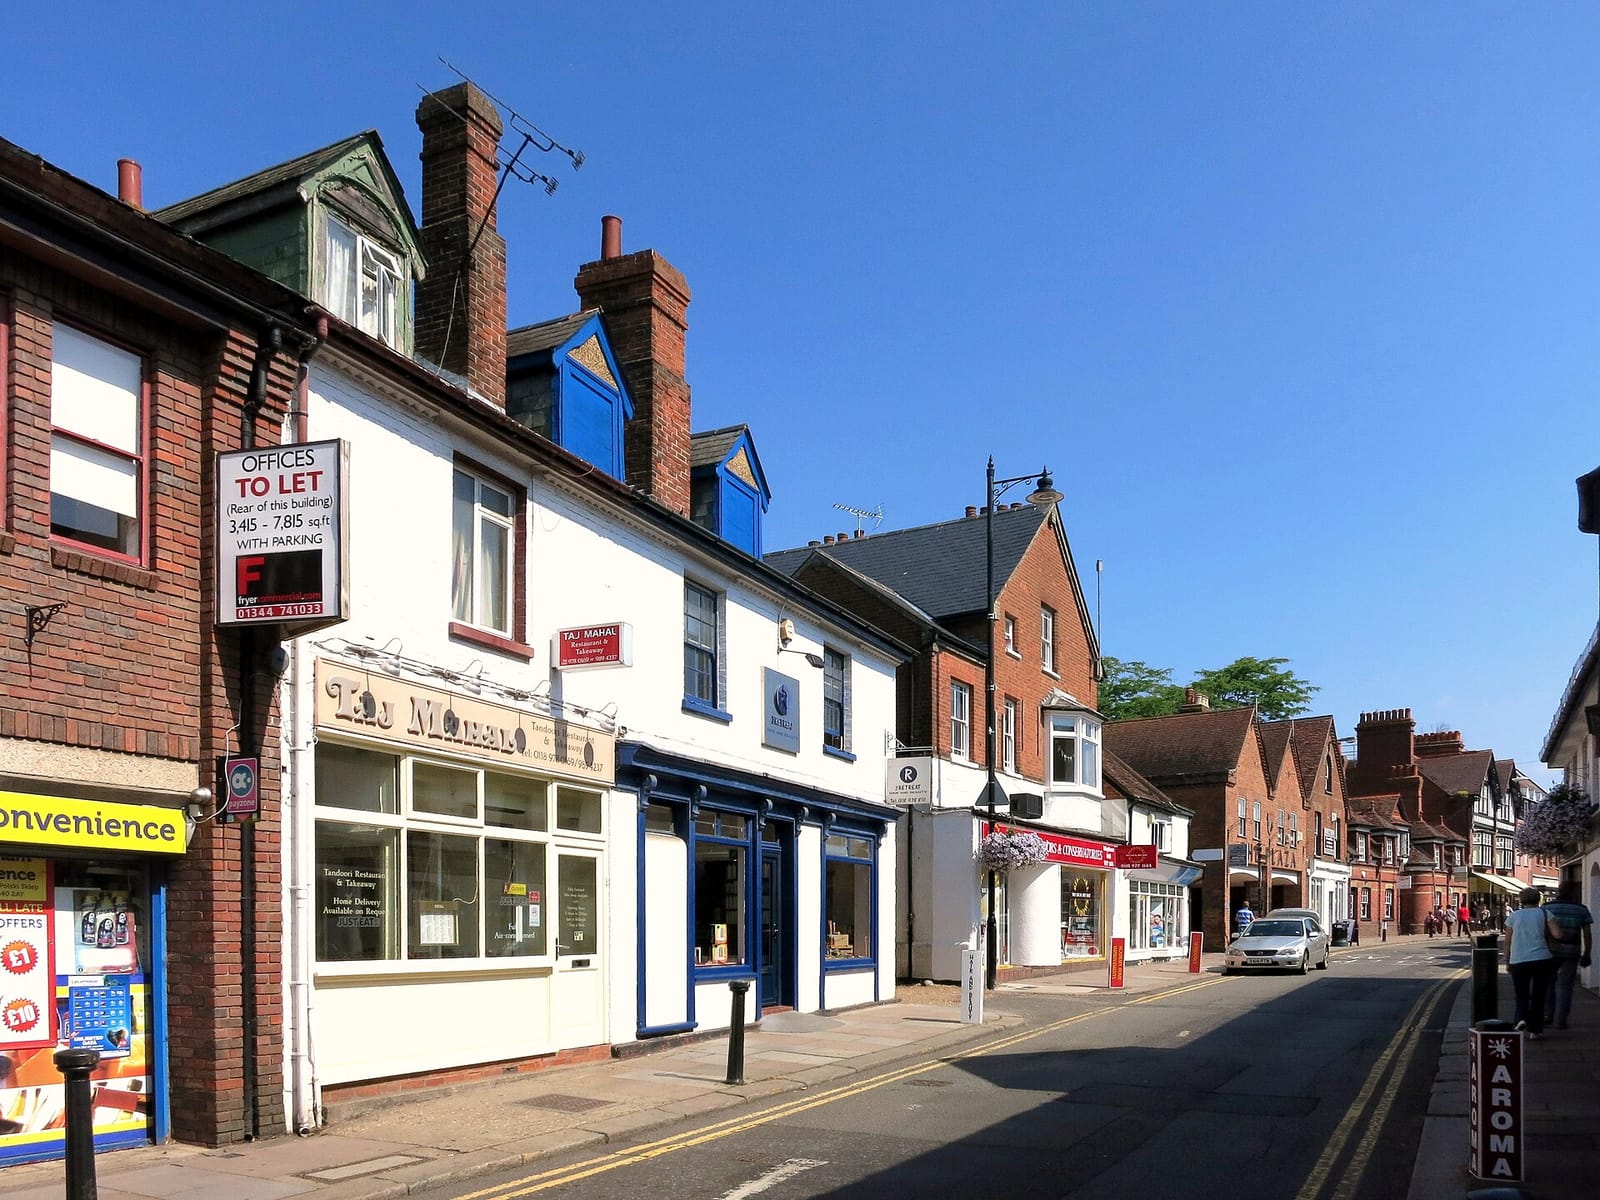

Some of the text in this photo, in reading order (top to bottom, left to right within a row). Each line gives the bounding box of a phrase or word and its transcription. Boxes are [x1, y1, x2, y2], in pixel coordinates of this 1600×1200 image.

[242, 449, 315, 472] OFFICES
[235, 471, 323, 498] TO LET
[226, 494, 333, 517] (Rear of this building)
[229, 518, 257, 534] 3,415
[273, 514, 303, 530] 7,815
[308, 515, 330, 528] sq.ft
[237, 533, 323, 550] WITH PARKING
[237, 557, 265, 596] F
[238, 604, 321, 618] 01344 741033
[563, 627, 617, 641] TAJ MAHAL
[571, 639, 602, 648] Restaurant
[576, 647, 604, 655] Takeaway
[543, 736, 550, 745] &
[229, 800, 256, 809] payzone
[1271, 847, 1296, 868] LAZA
[0, 869, 36, 880] ence
[324, 868, 385, 879] Tandoori Restauran
[345, 879, 376, 889] Takeaway
[15, 903, 43, 913] LATE
[333, 897, 381, 907] Home Delivery
[323, 906, 353, 914] Available
[366, 908, 385, 917] Reque
[0, 918, 43, 929] OFFERS
[8, 947, 31, 968] £1
[7, 1004, 36, 1027] £10
[1489, 1064, 1514, 1177] AROMA
